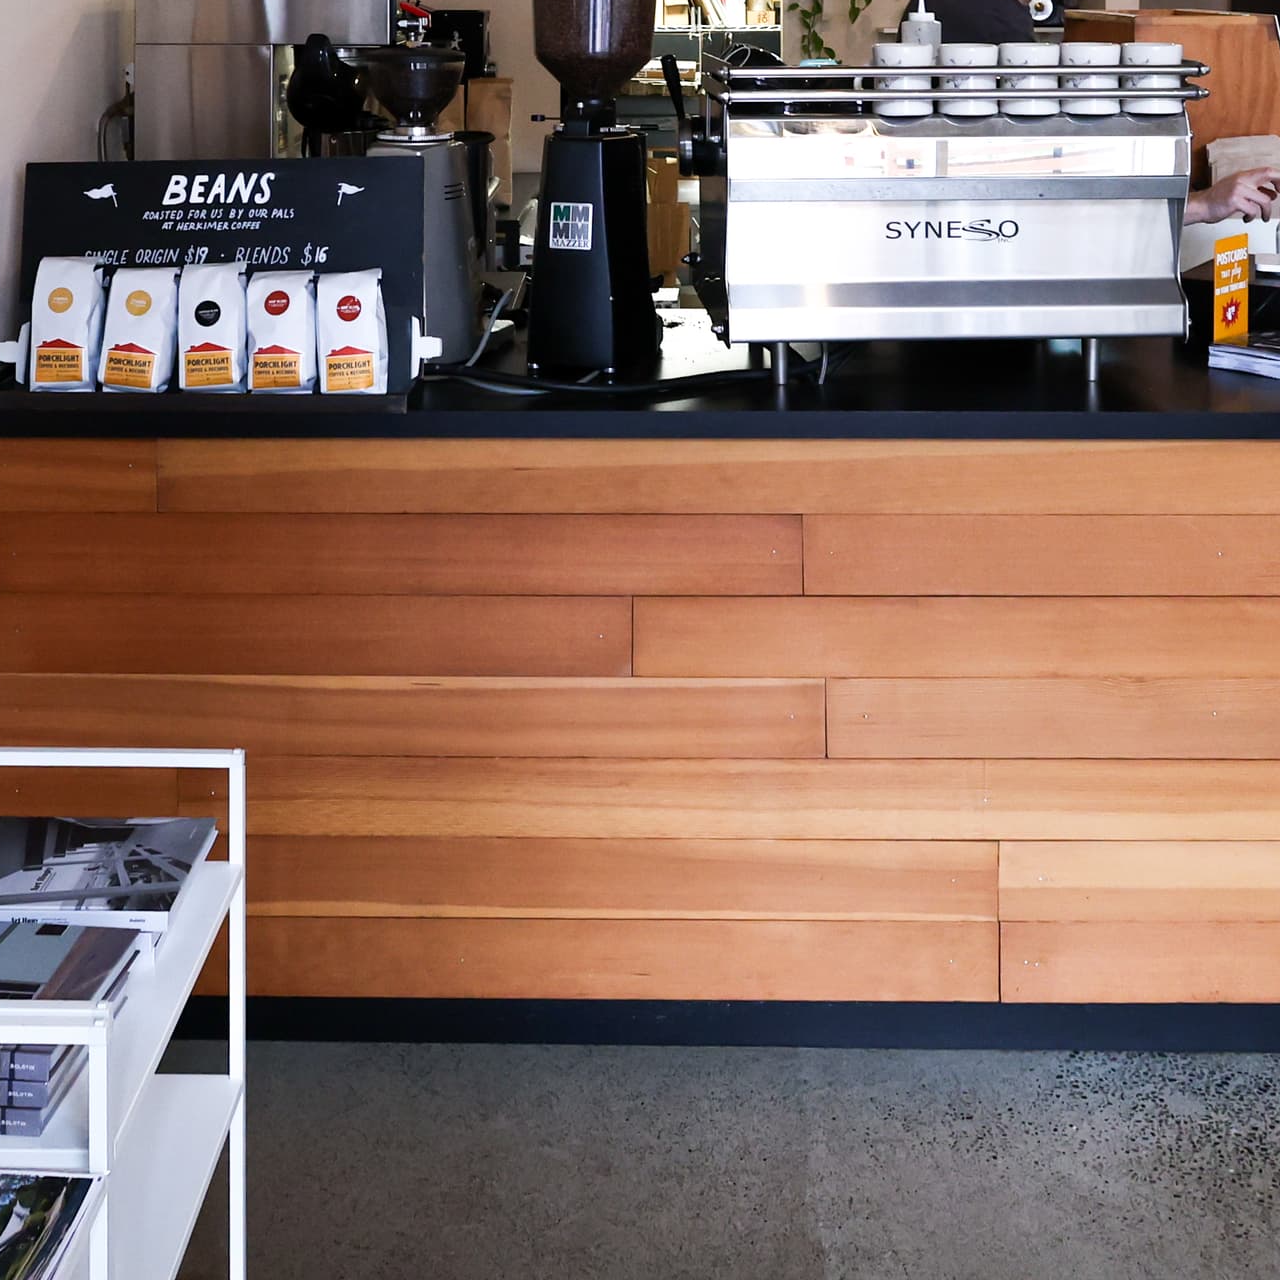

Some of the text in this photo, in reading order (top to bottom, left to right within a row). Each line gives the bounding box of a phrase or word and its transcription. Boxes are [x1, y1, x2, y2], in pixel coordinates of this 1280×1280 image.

[162, 172, 275, 206] BEANS
[143, 208, 295, 220] ROASTED FOR US BY OUR PALS
[161, 221, 261, 231] AT HERKIMER COFFEE
[885, 219, 1019, 241] SYNESSO
[552, 239, 589, 248] MAZZER
[135, 247, 180, 264] ORIGIN
[185, 245, 208, 266] $19
[235, 246, 291, 265] BLENDS
[301, 242, 329, 266] $16
[1216, 247, 1248, 266] POSTCARDS
[38, 354, 79, 363] PORCHLIGHT
[109, 357, 151, 368] PORCHLIGHT
[187, 357, 229, 367] PORCHLIGHT
[255, 360, 297, 369] PORCHLIGHT
[328, 360, 370, 370] PORCHLIGHT
